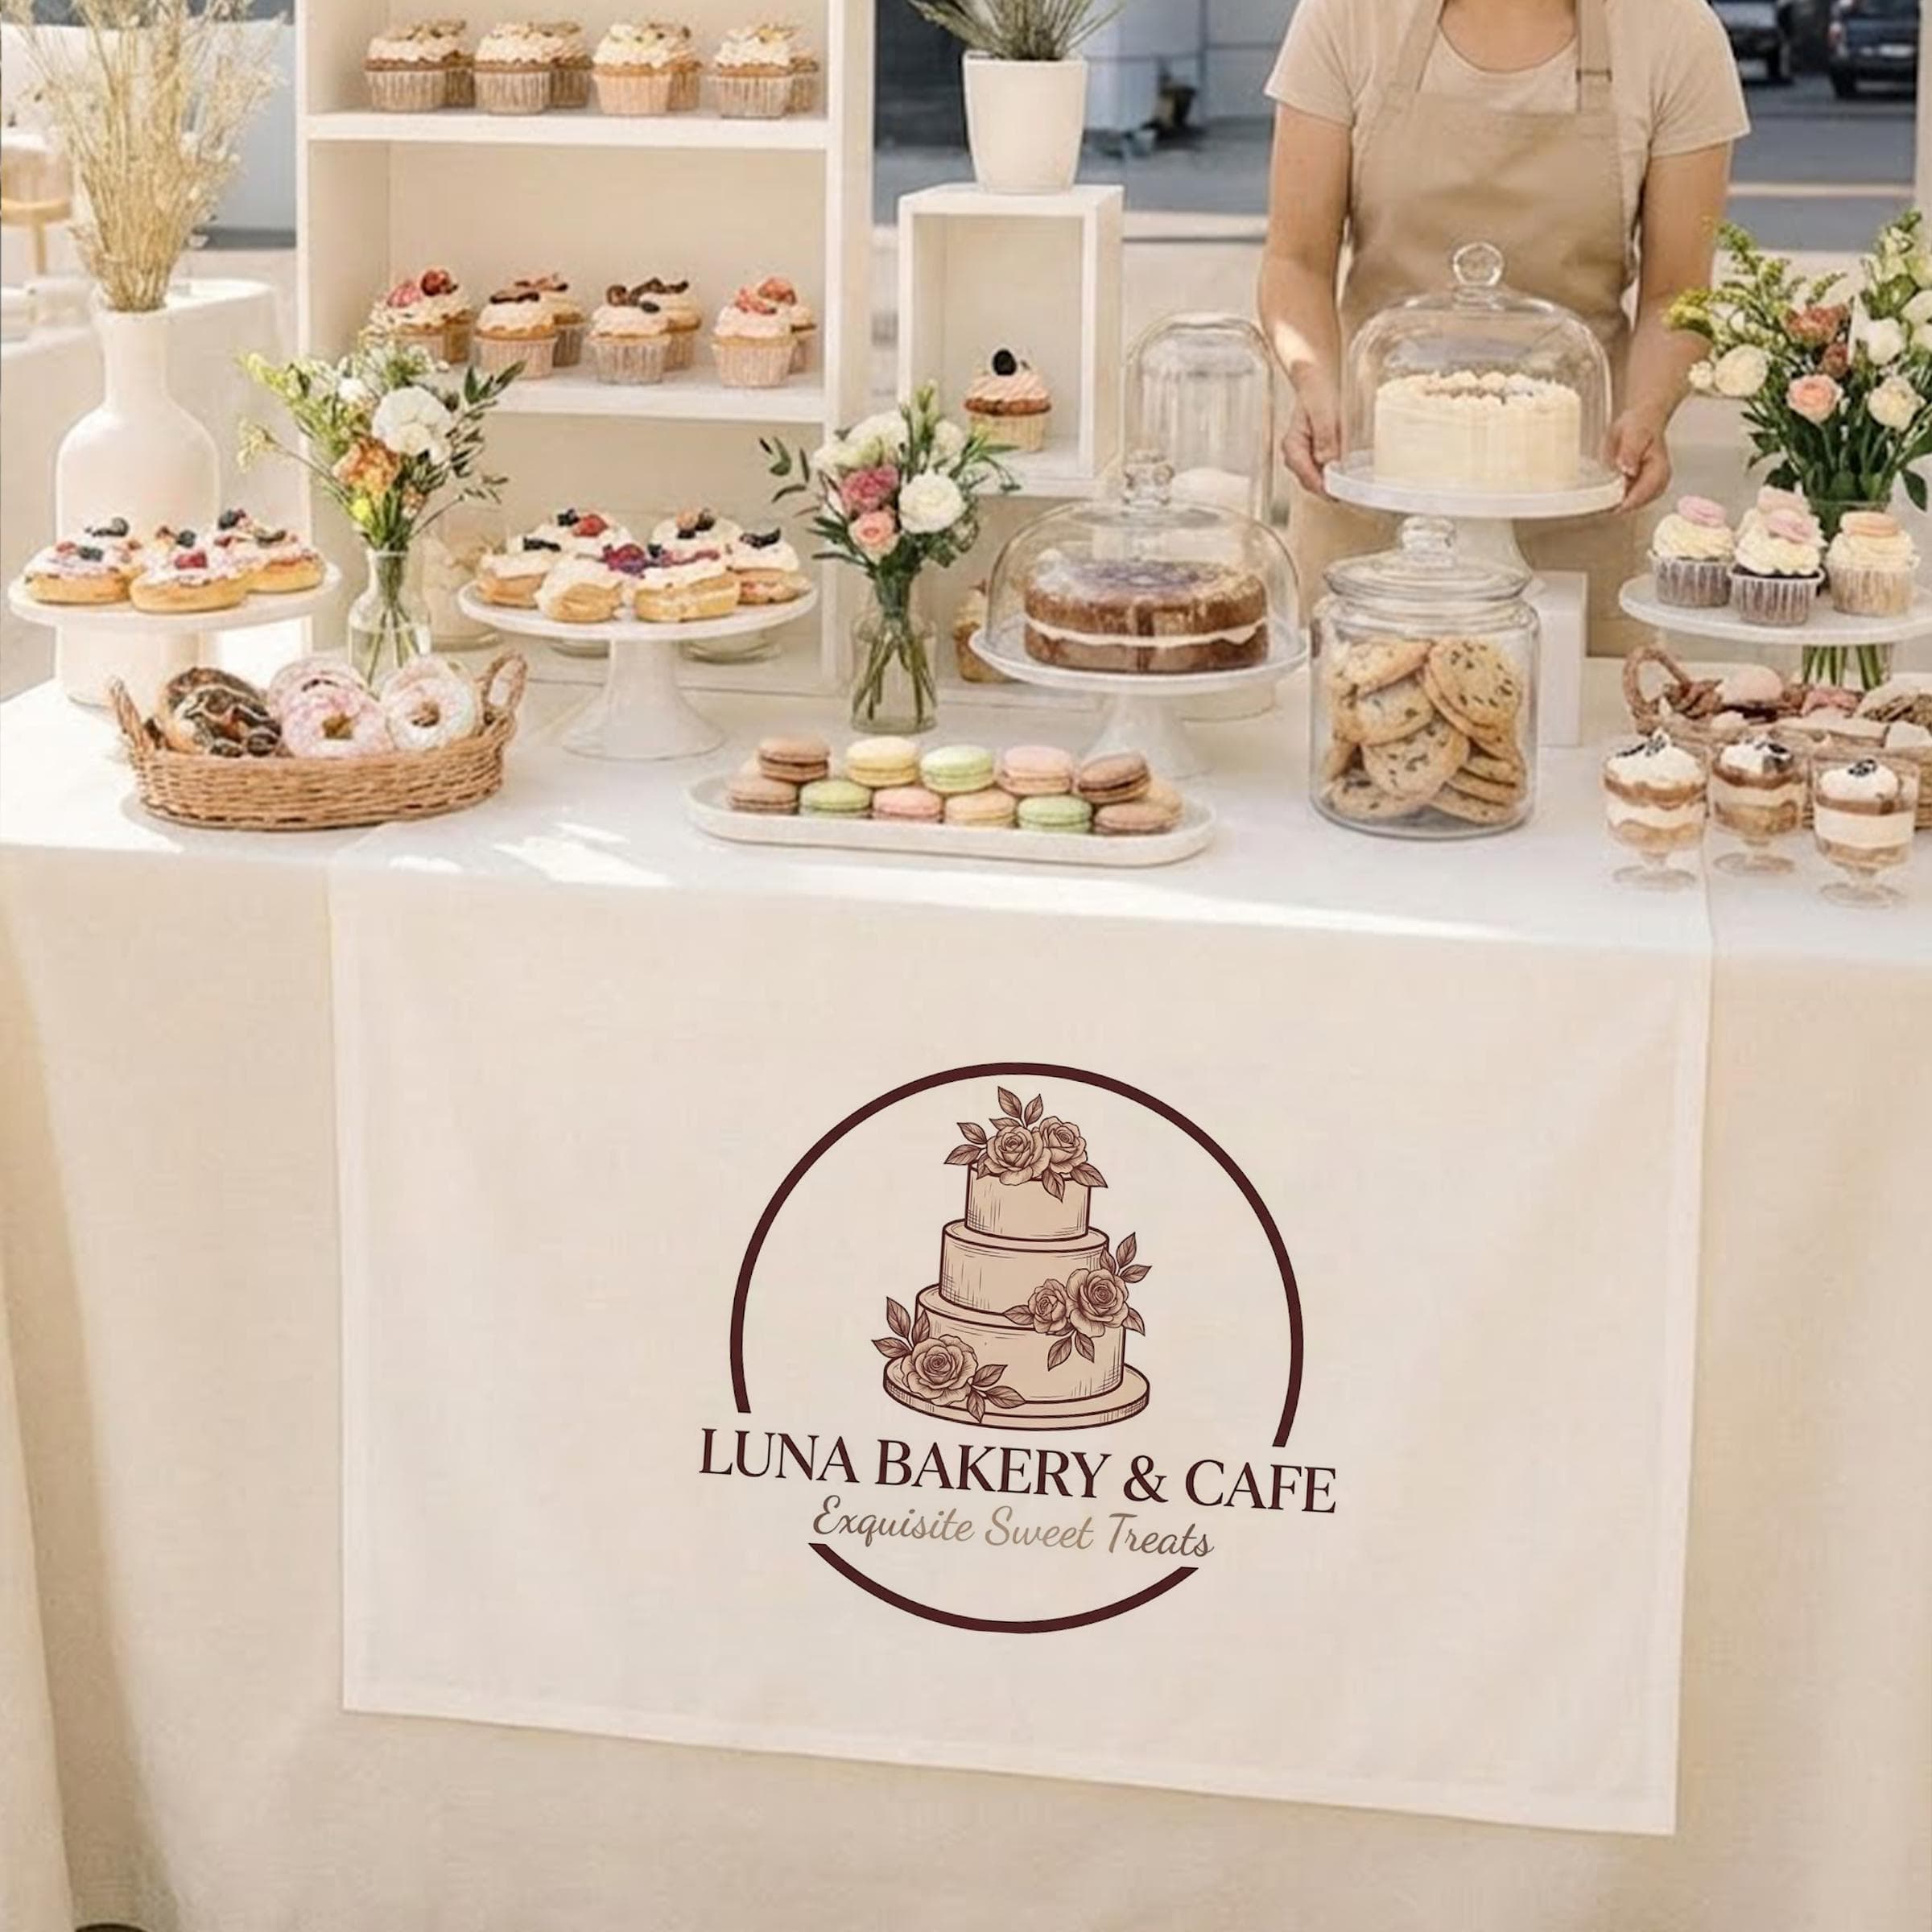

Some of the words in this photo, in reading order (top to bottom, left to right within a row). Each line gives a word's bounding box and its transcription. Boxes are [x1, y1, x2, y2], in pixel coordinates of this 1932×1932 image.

[698, 1427, 861, 1484] LUNA
[874, 1439, 1113, 1499] BAKERY
[1122, 1454, 1170, 1504] &
[1184, 1459, 1336, 1514] CAFE
[811, 1493, 976, 1548] Exquisite
[985, 1505, 1095, 1550] Sweet
[1108, 1512, 1216, 1558] Treats
